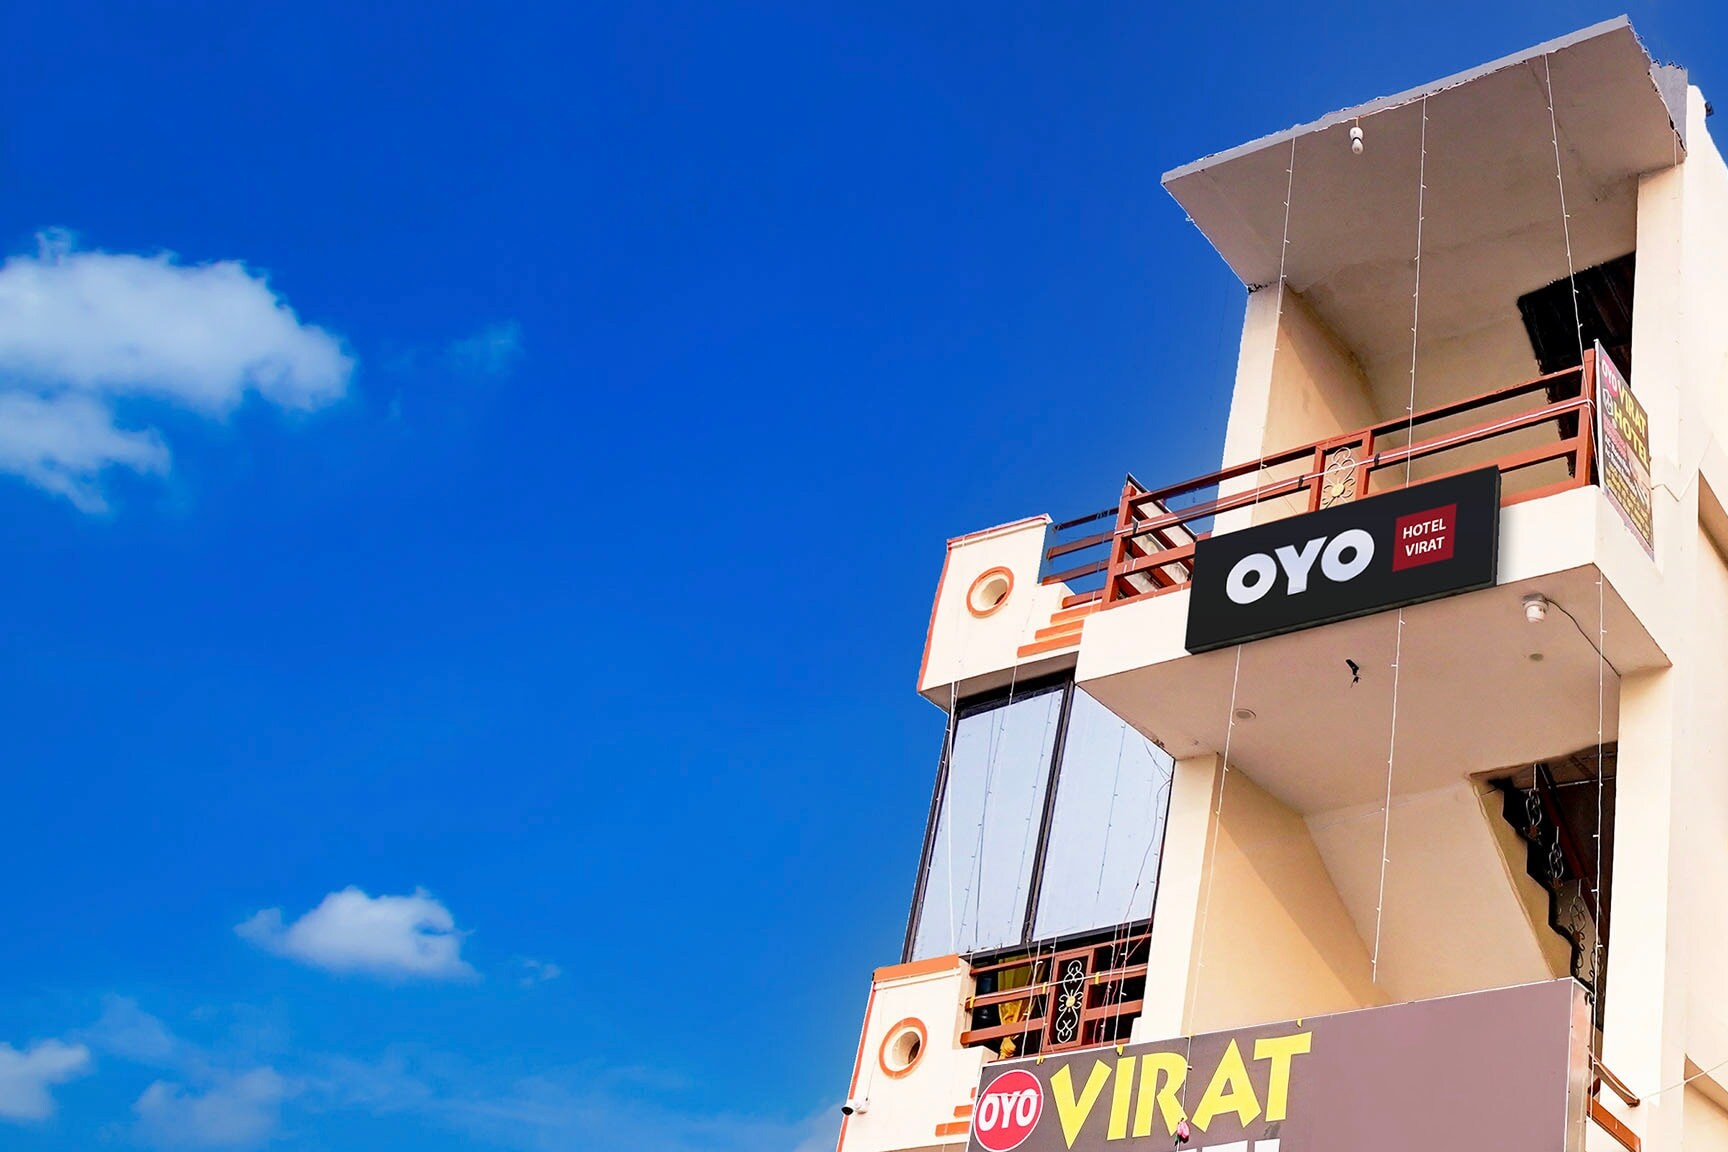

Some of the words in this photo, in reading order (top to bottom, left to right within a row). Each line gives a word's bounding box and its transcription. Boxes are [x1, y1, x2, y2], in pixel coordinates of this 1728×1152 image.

[1403, 518, 1447, 540] HOTEL
[1405, 536, 1445, 557] VIRAT
[1226, 528, 1375, 604] OYO
[977, 1088, 1038, 1132] OYO
[1050, 1031, 1312, 1150] VIRAT
